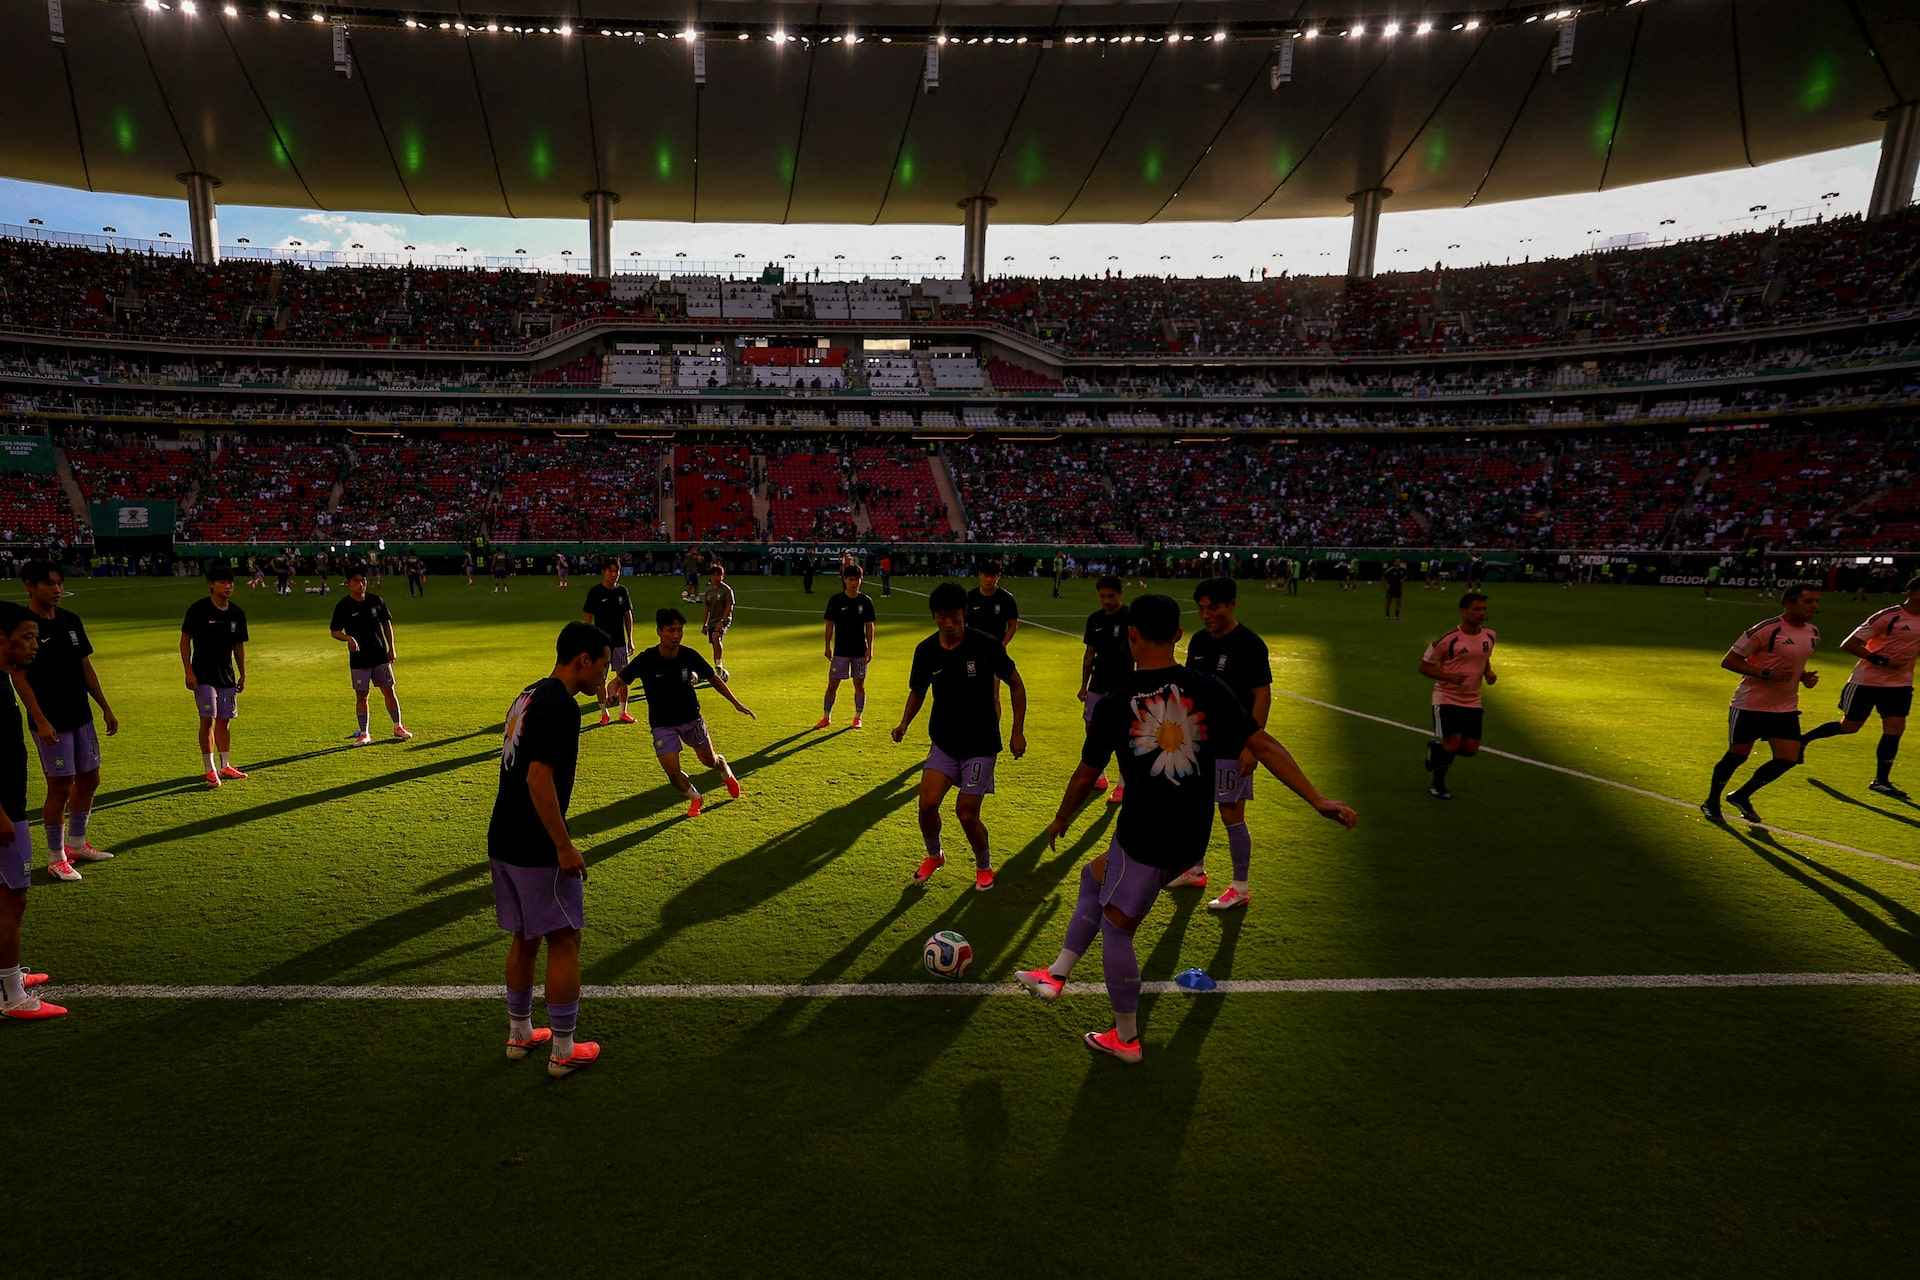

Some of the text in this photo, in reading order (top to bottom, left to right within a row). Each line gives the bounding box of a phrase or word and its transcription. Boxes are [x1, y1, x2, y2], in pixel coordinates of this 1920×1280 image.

[0, 370, 69, 381] UADALAJARA
[1659, 575, 1713, 585] ESCUCH
[1719, 577, 1746, 586] LAS
